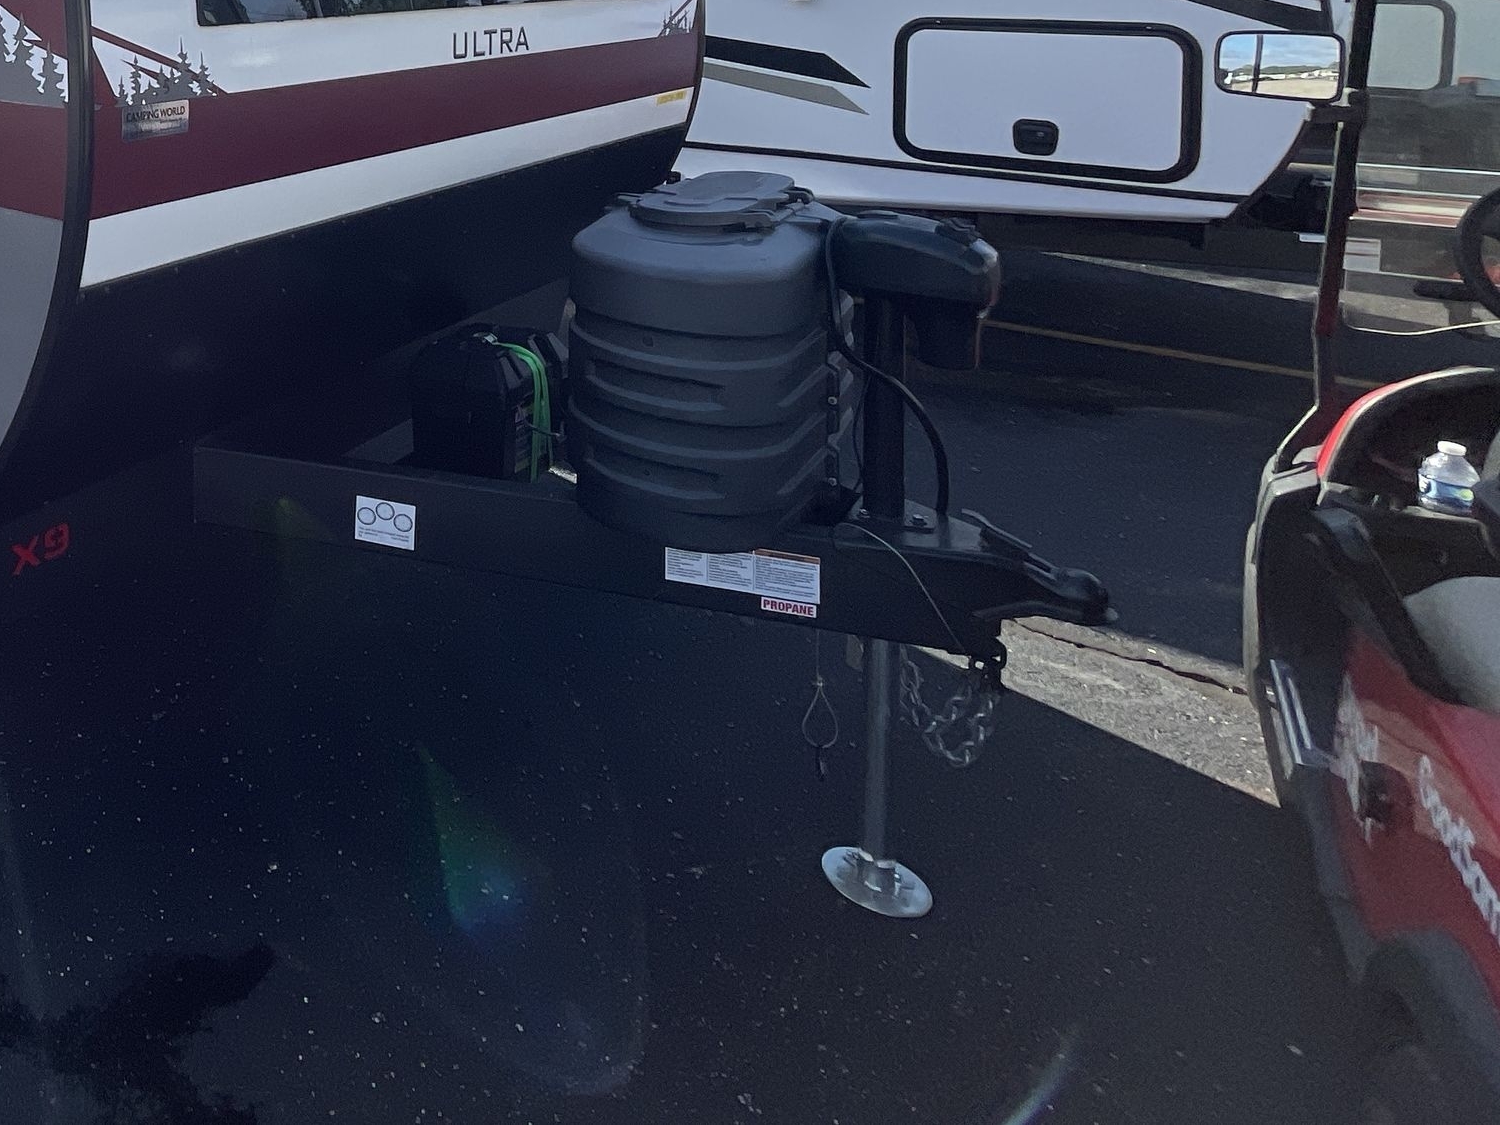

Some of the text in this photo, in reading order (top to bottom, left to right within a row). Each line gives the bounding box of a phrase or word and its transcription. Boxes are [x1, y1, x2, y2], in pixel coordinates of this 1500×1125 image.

[453, 26, 530, 59] ULTRA
[126, 109, 159, 123] CAMPING
[160, 106, 185, 118] WORLD
[11, 523, 69, 577] X9
[763, 599, 814, 616] PROPANE
